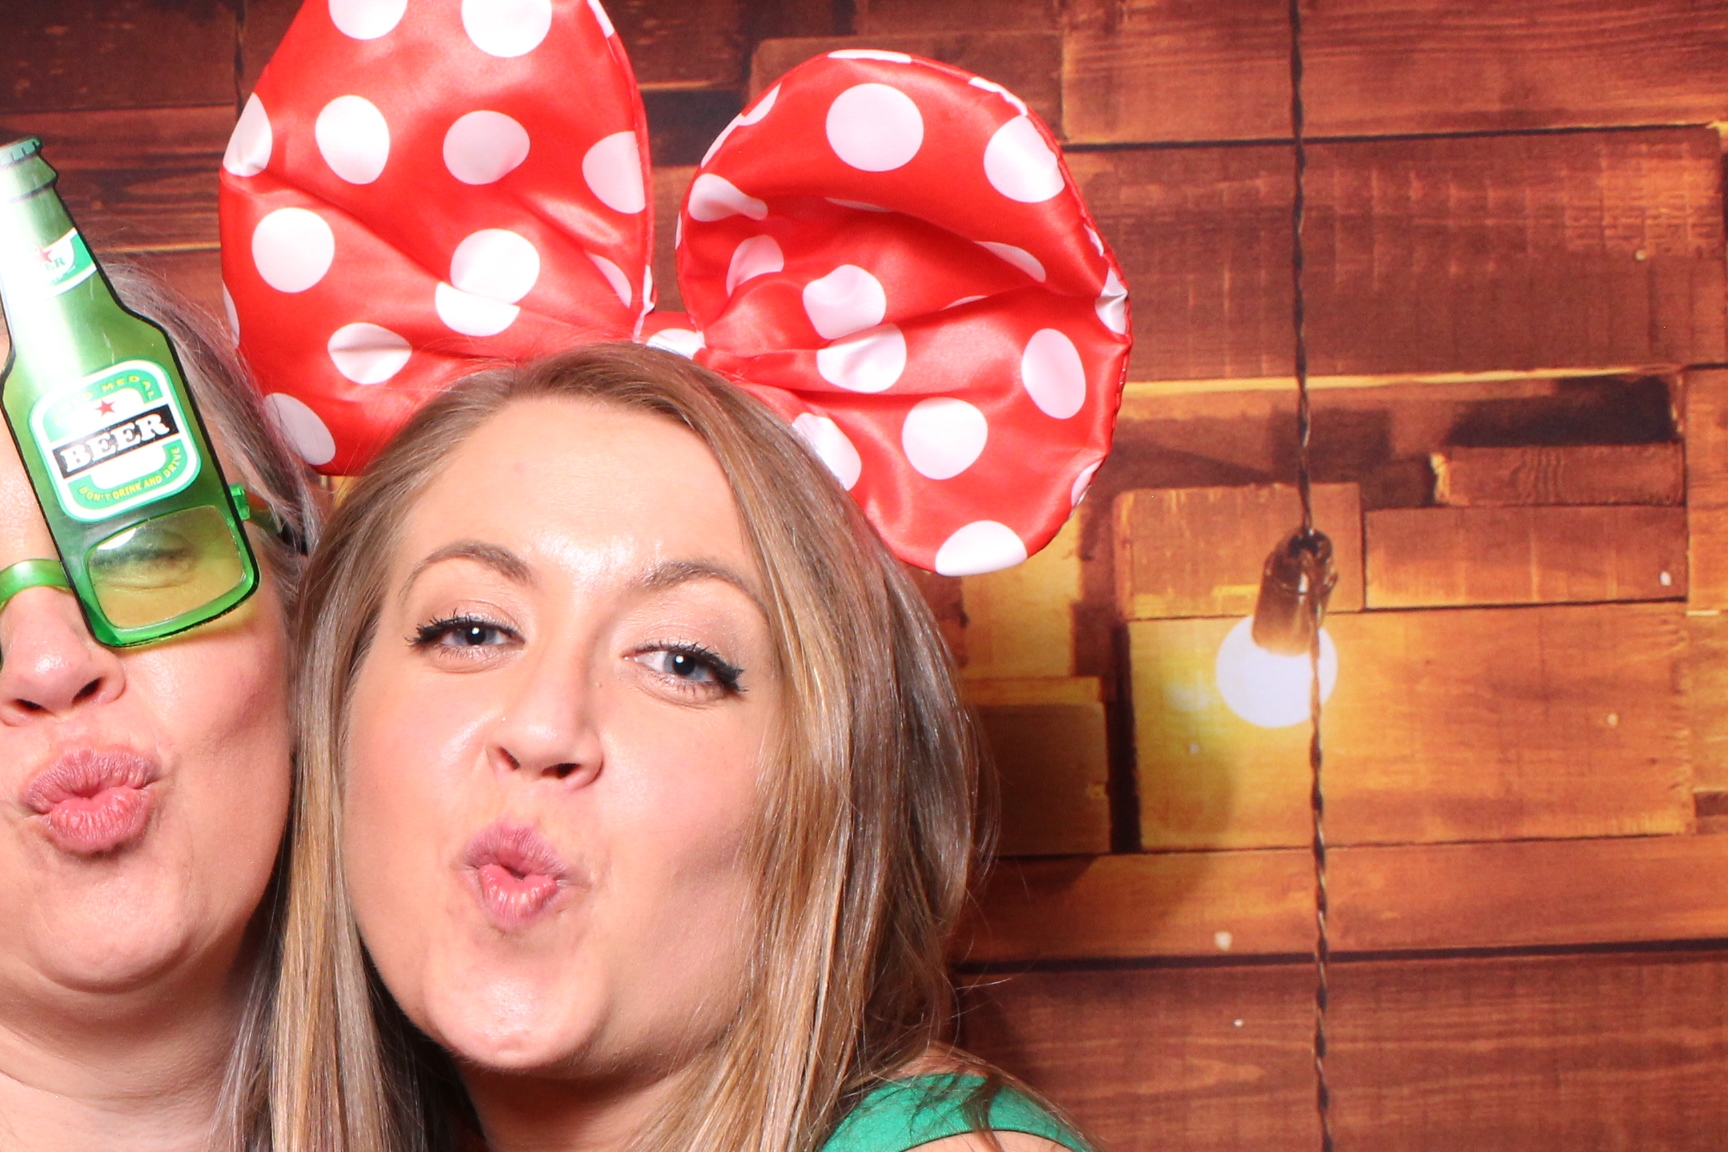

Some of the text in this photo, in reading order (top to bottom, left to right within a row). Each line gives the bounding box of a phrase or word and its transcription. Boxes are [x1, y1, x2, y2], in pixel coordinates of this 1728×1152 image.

[100, 375, 155, 401] MEDAL
[59, 413, 171, 474] BEER
[78, 447, 182, 502] DON'T DRINK AND DRIVE
